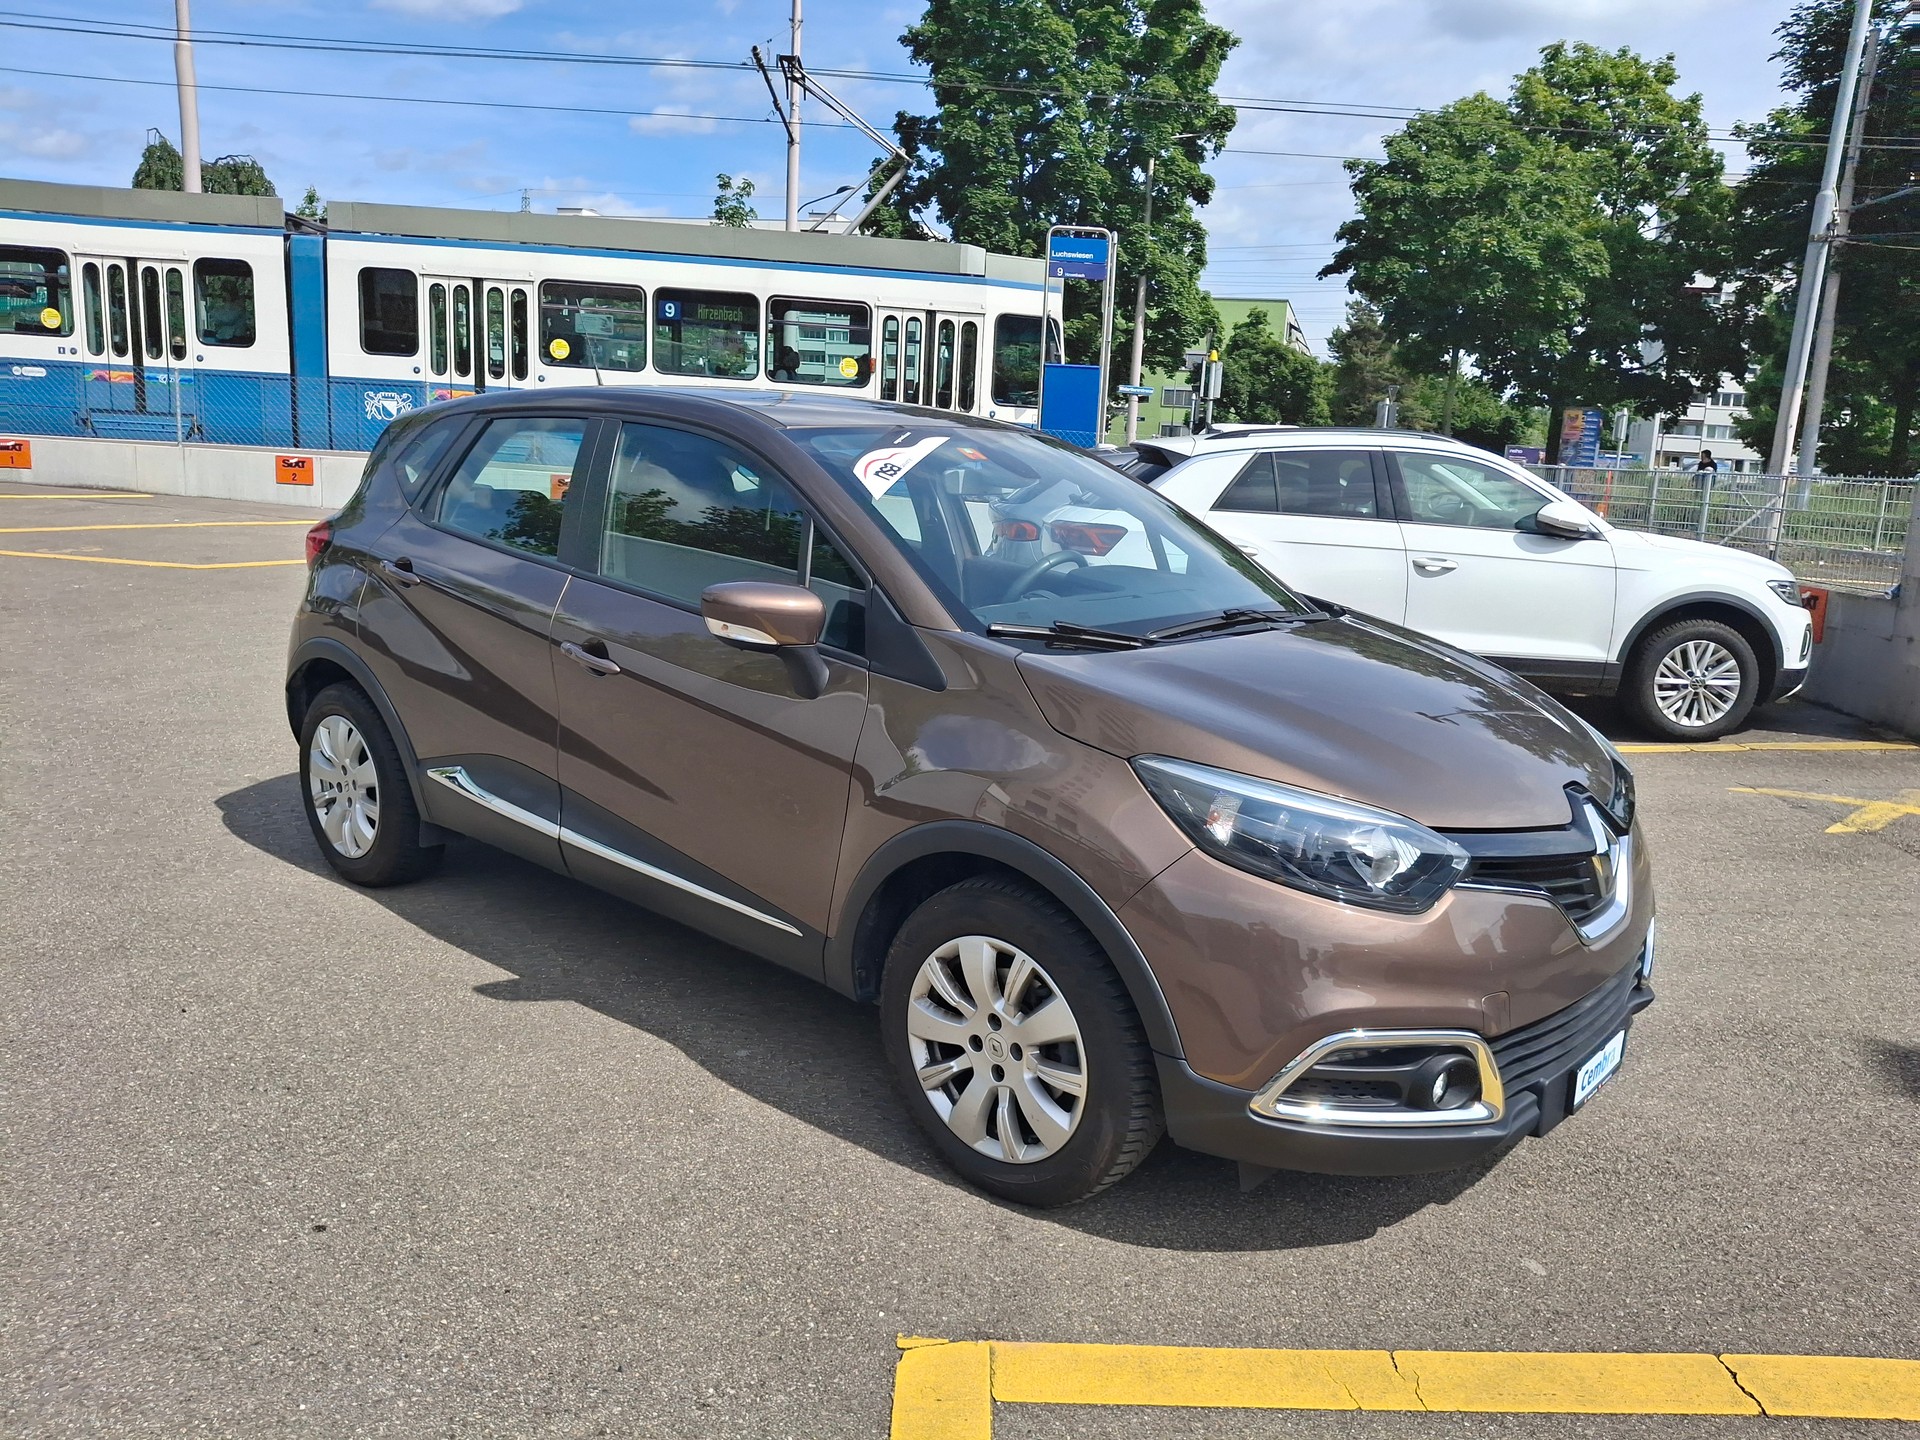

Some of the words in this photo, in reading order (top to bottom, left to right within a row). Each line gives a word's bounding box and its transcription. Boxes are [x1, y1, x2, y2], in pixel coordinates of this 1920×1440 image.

[1051, 250, 1094, 259] Luchswiesen
[1057, 267, 1064, 277] 9
[664, 302, 676, 318] 9
[697, 303, 744, 322] Hirzenbach
[10, 455, 14, 465] 1
[873, 462, 902, 481] nsa
[291, 472, 298, 482] 2
[1580, 1046, 1617, 1092] Cembra
